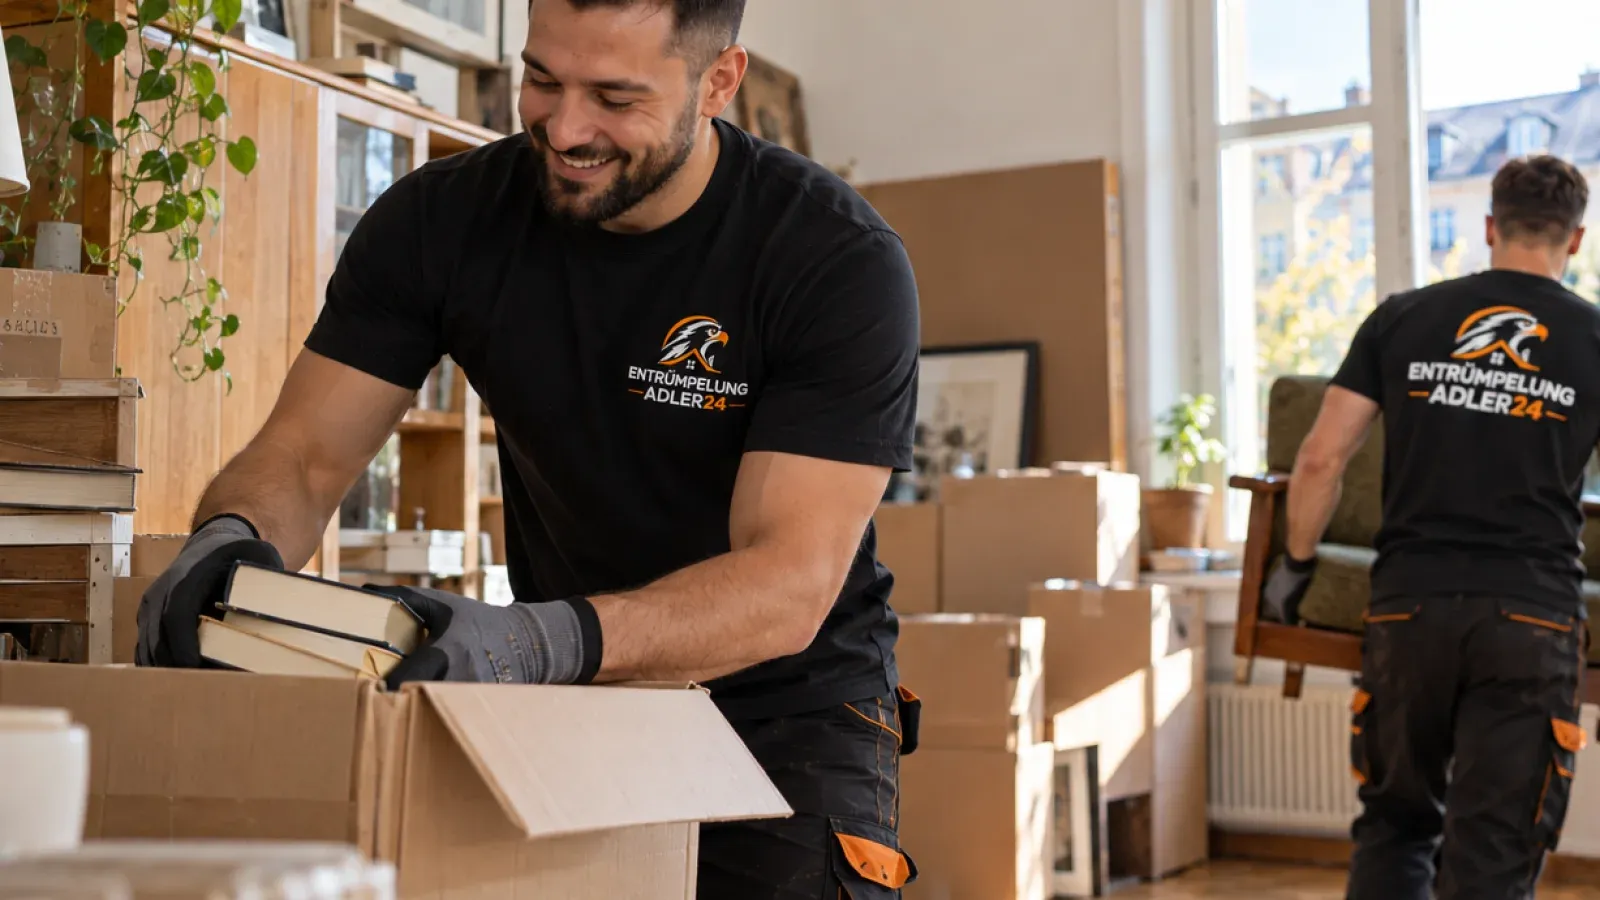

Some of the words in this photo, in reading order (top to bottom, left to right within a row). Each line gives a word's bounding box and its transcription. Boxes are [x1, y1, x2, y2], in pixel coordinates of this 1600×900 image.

[628, 366, 748, 395] ENTRÜMPELUNG
[1408, 361, 1576, 406] ENTRÜMPELUNG
[643, 386, 727, 411] ADLER24
[1428, 384, 1544, 421] ADLER24
